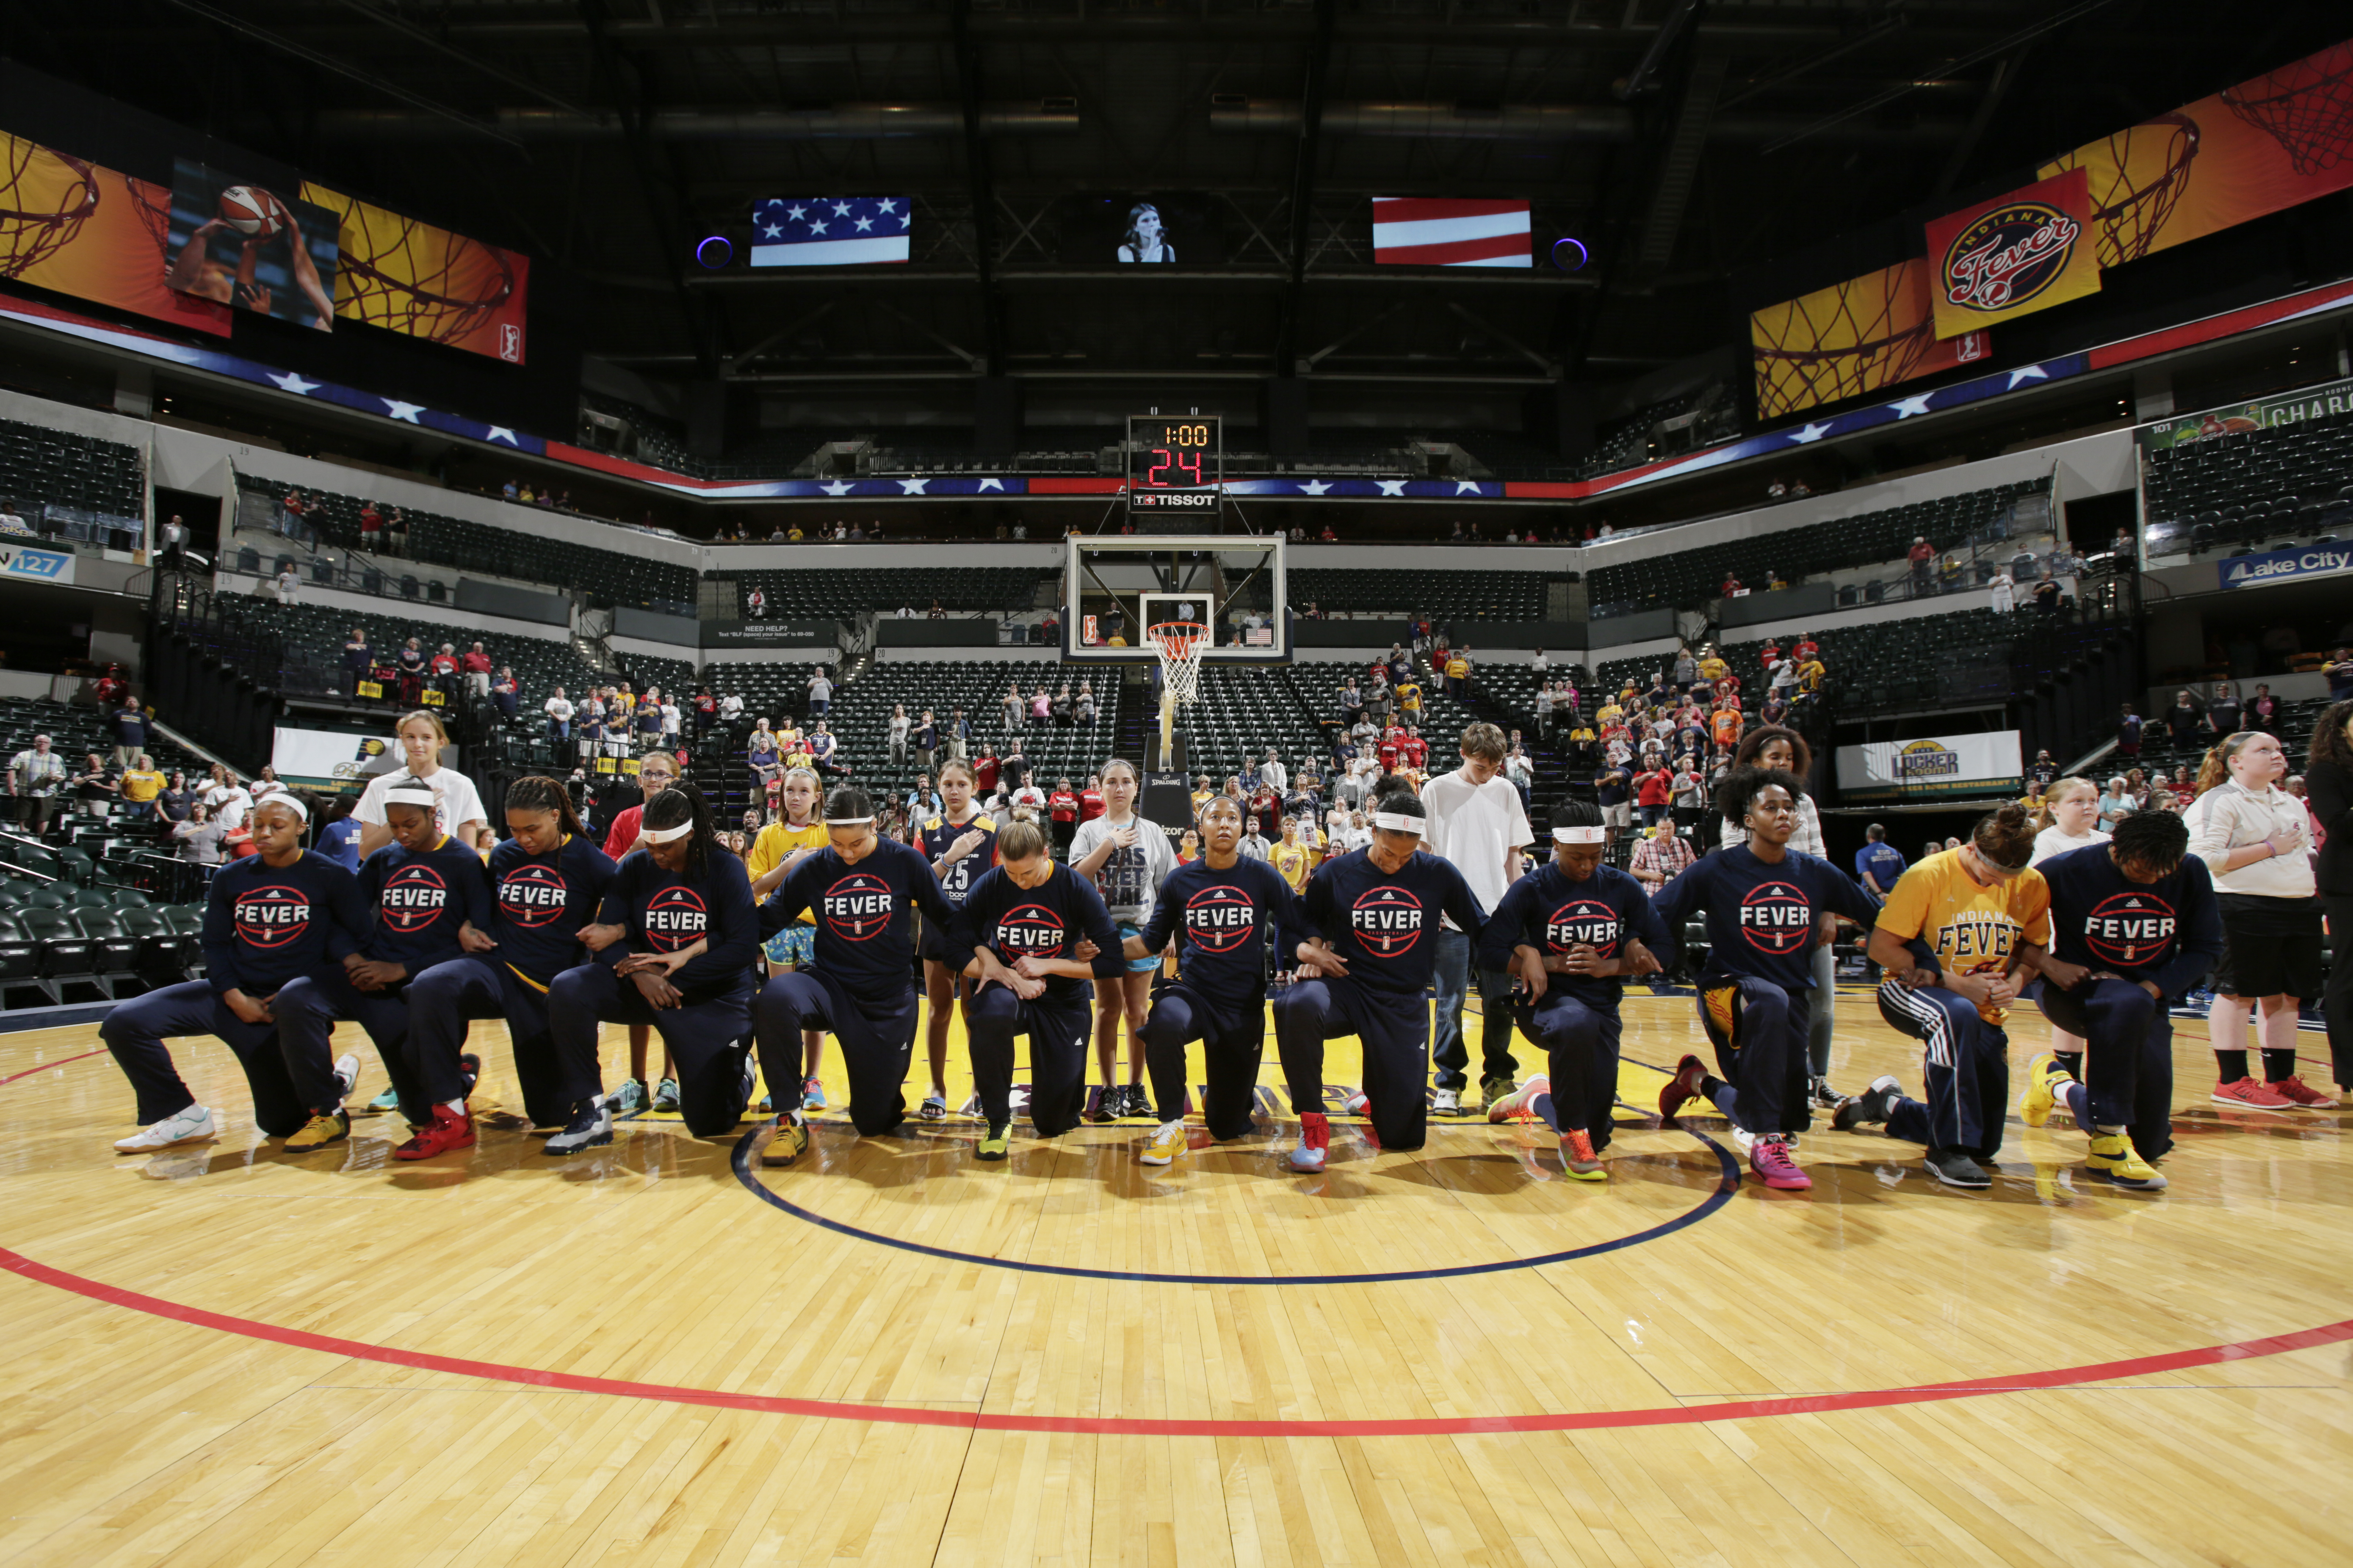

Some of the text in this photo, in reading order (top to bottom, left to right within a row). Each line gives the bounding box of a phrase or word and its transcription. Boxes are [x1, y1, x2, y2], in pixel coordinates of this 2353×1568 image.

[1958, 212, 2046, 255] INDIANA
[1946, 217, 2079, 304] Fever
[2325, 381, 2353, 396] RODNE
[1167, 425, 1207, 446] 1:00
[2151, 424, 2172, 434] 101
[239, 447, 249, 455] 19
[1148, 450, 1200, 486] 24
[1156, 495, 1215, 505] TISSOT
[17, 555, 58, 573] 127
[2231, 551, 2350, 581] Lake City
[220, 574, 232, 584] 19
[828, 649, 834, 657] 19
[878, 649, 885, 657] 20
[1405, 650, 1407, 658] 1
[1893, 752, 1959, 777] LOCKER
[1906, 766, 1948, 776] ROOM
[288, 782, 342, 792] RESTROOMS
[1952, 780, 2011, 790] RESTAURANT
[382, 889, 447, 906] FEVER
[500, 884, 566, 906] FEVER
[824, 894, 892, 915] FEVER
[235, 904, 310, 923] FEVER
[646, 911, 707, 930] FEVER
[1186, 907, 1253, 927] FEVER
[1352, 910, 1422, 929] FEVER
[1740, 906, 1810, 925] FEVER
[1951, 910, 2016, 925] INDIANA
[997, 926, 1064, 946] FEVER
[1546, 922, 1617, 944] FEVER
[2084, 917, 2176, 939] FEVER
[1934, 922, 2024, 958] FEVE
